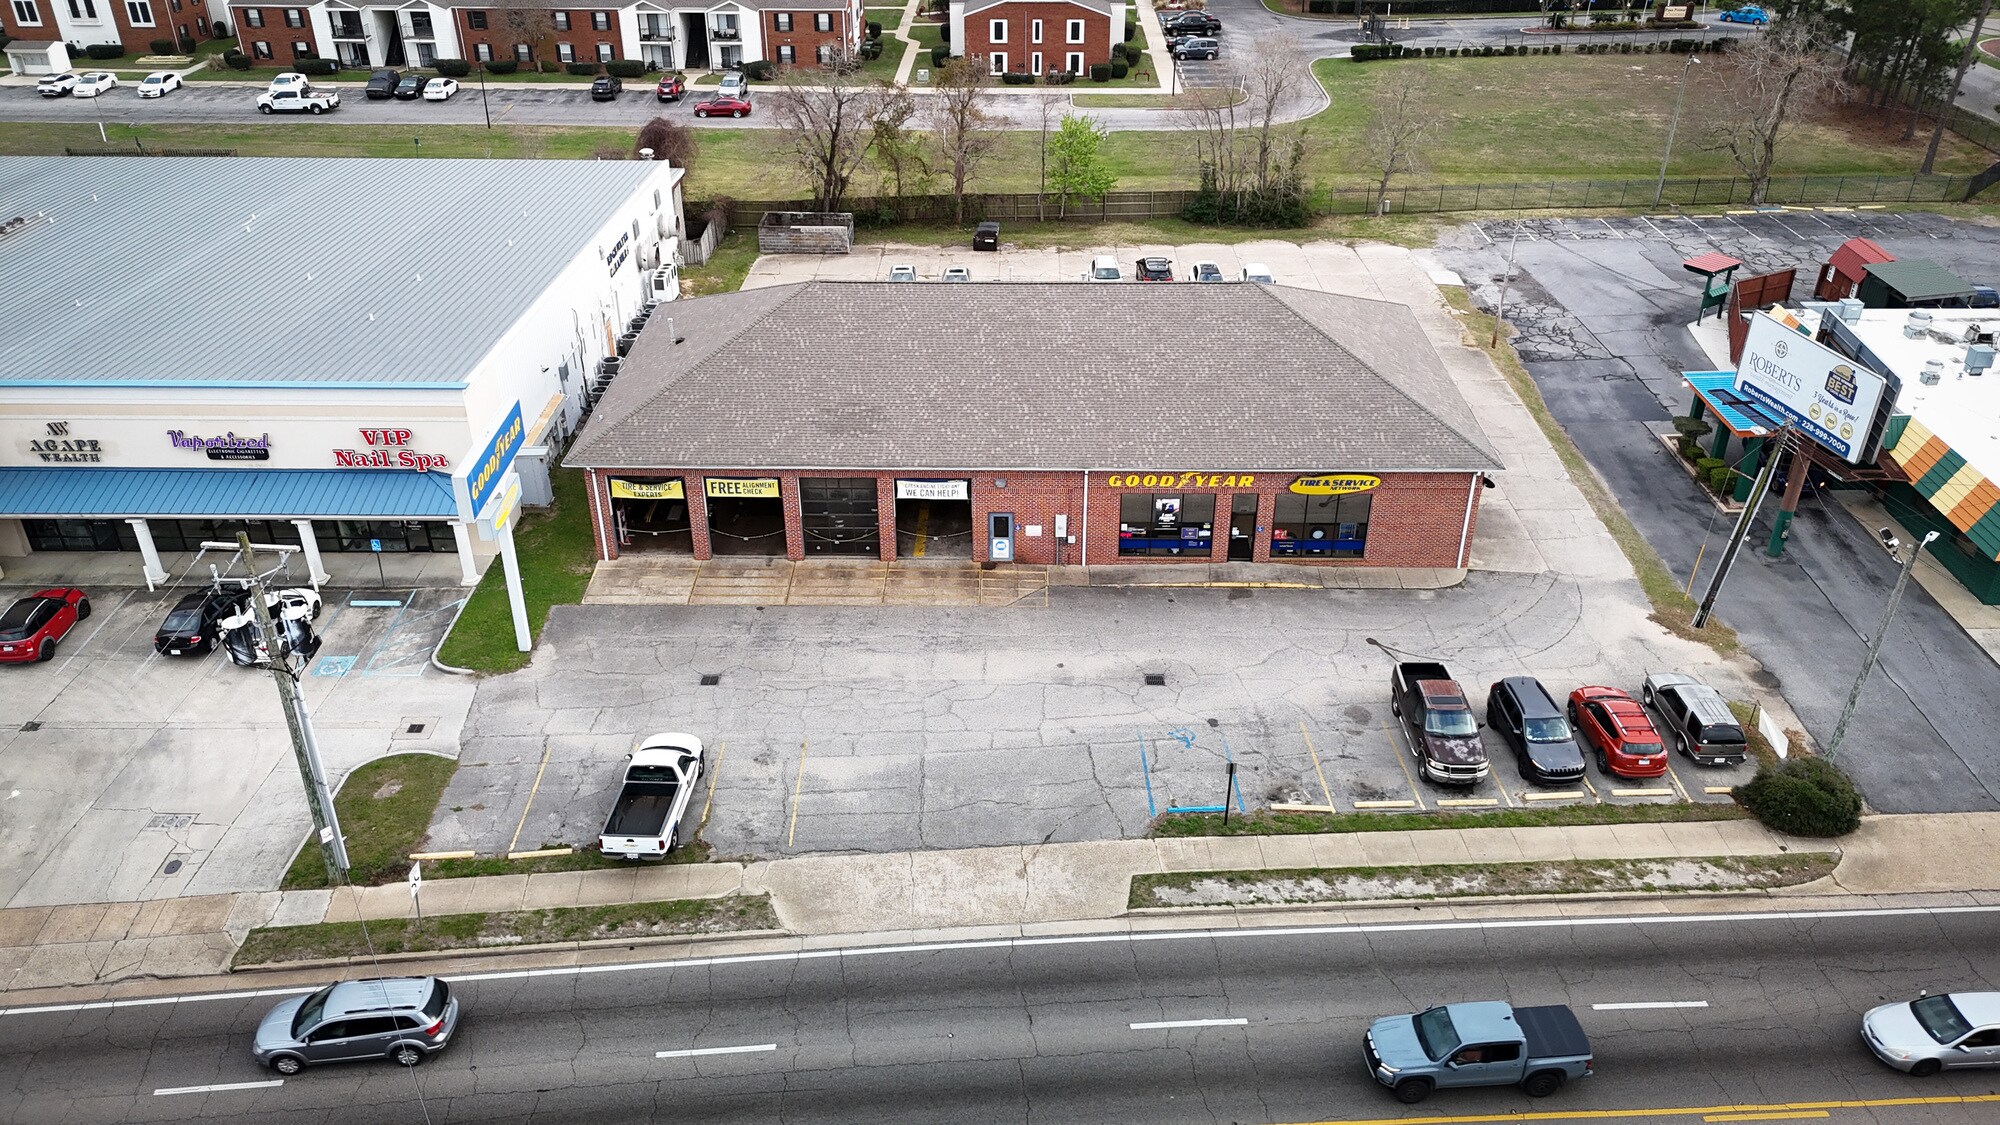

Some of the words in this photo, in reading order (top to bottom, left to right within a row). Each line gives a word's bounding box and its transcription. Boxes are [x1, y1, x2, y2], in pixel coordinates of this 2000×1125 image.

[1749, 351, 1802, 392] ROBERTS
[1828, 376, 1855, 399] BEST
[1743, 384, 1799, 423] RobertsWealth.com
[167, 430, 271, 451] Vaporized
[359, 428, 413, 446] VIP
[1801, 420, 1846, 452] 228-999-7000
[30, 439, 101, 452] AGAPE
[39, 453, 101, 463] WEALTH
[332, 449, 393, 468] Nail
[397, 449, 449, 473] Spa
[622, 482, 637, 491] TIRE
[639, 483, 644, 491] &
[645, 483, 672, 491] SERVICE
[710, 482, 742, 494] FREE
[1300, 479, 1321, 487] TIRE
[1322, 479, 1330, 487] &
[1331, 479, 1376, 487] SERVICE
[920, 489, 935, 497] CAN
[937, 489, 959, 497] HELP!
